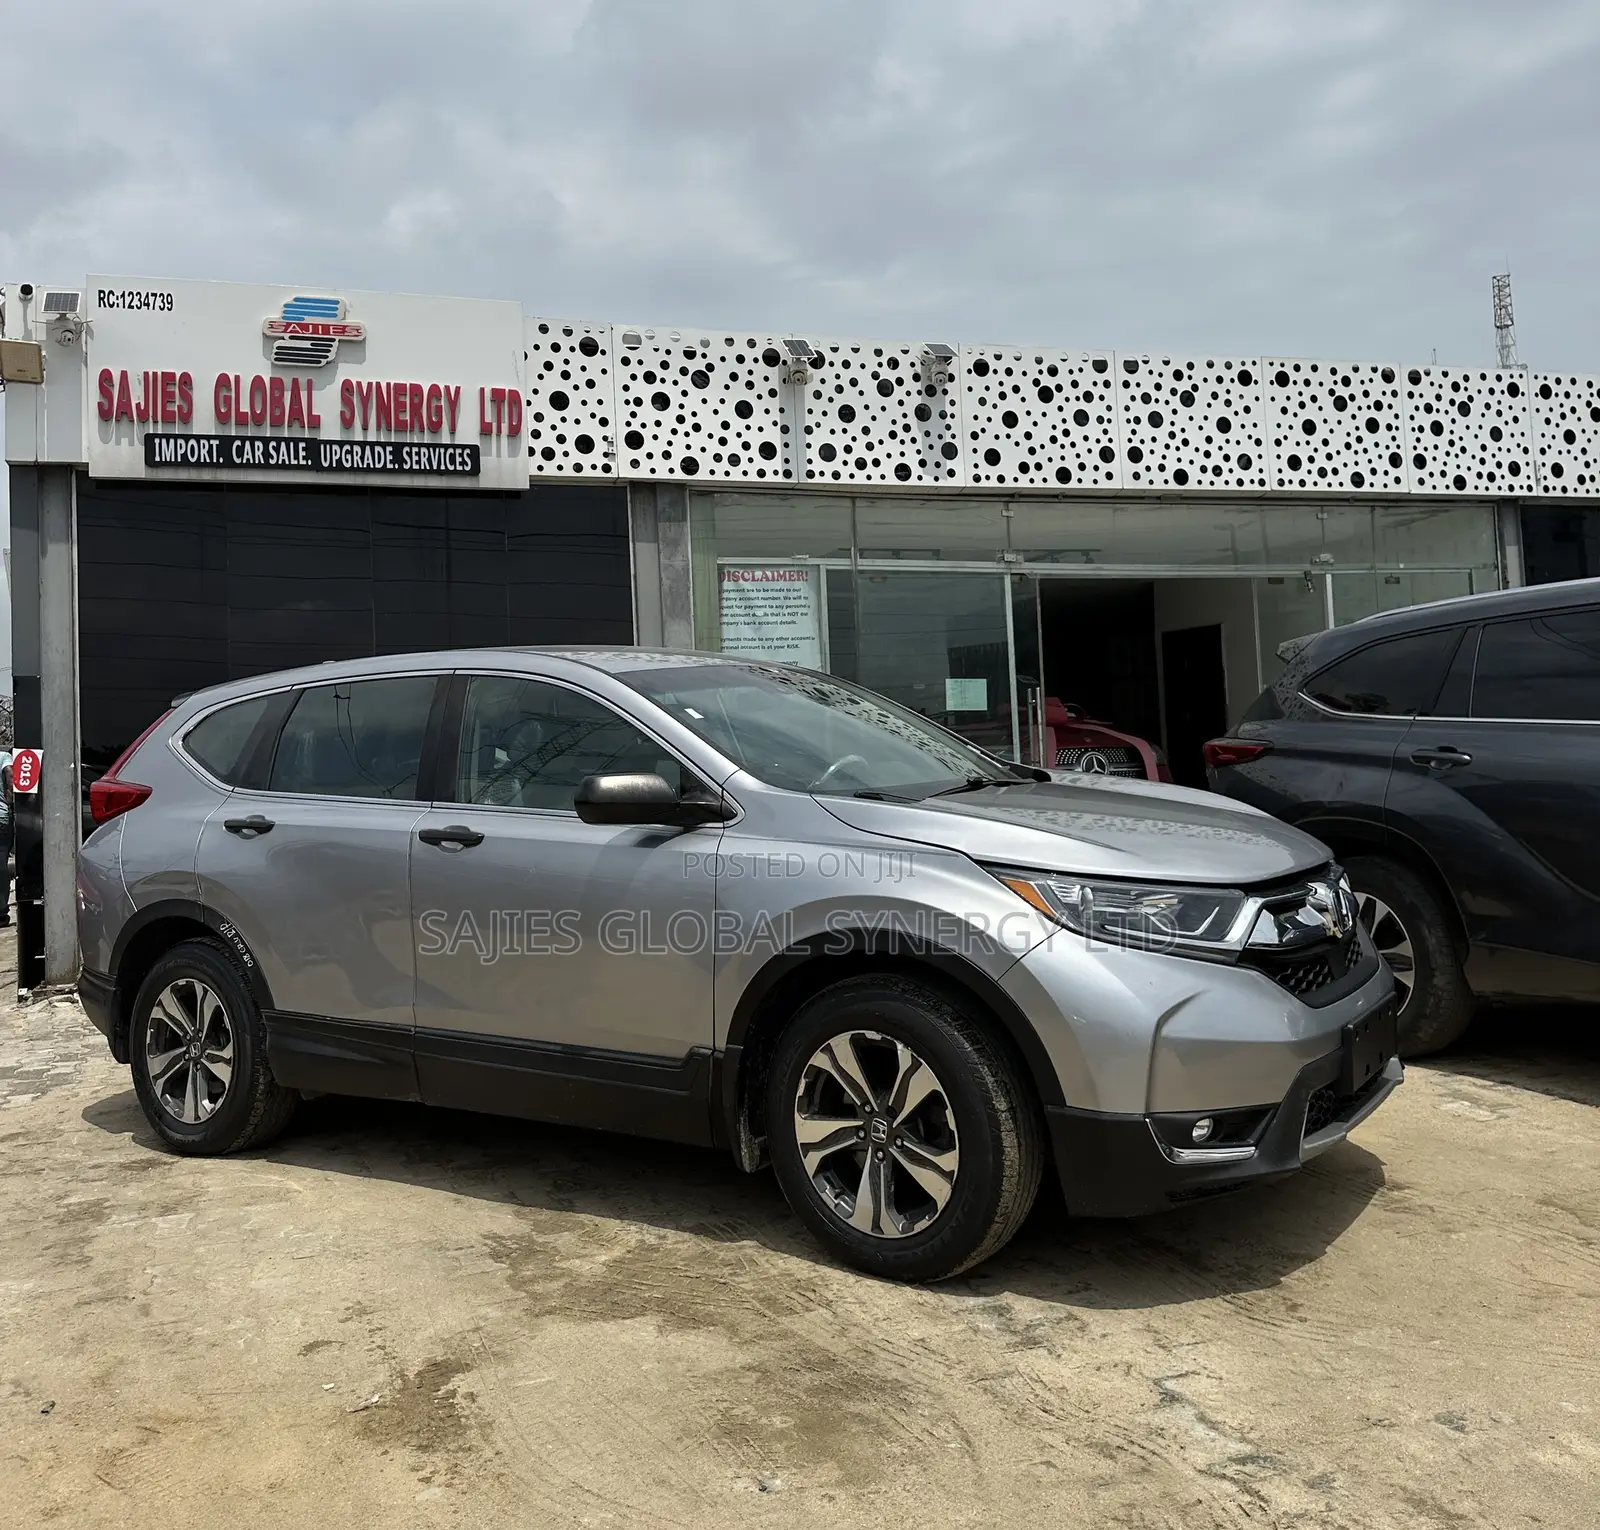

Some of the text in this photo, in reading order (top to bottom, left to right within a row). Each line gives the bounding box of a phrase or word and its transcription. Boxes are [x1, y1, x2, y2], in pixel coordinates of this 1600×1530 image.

[97, 289, 174, 311] RC:1234739
[267, 320, 362, 337] SAJIES
[97, 368, 523, 437] SAJIES GLOBAL SYNERGY LTD
[154, 438, 472, 471] IMPORT. CAR SALE. UPGRADE. SERVICES
[20, 756, 33, 786] 2013
